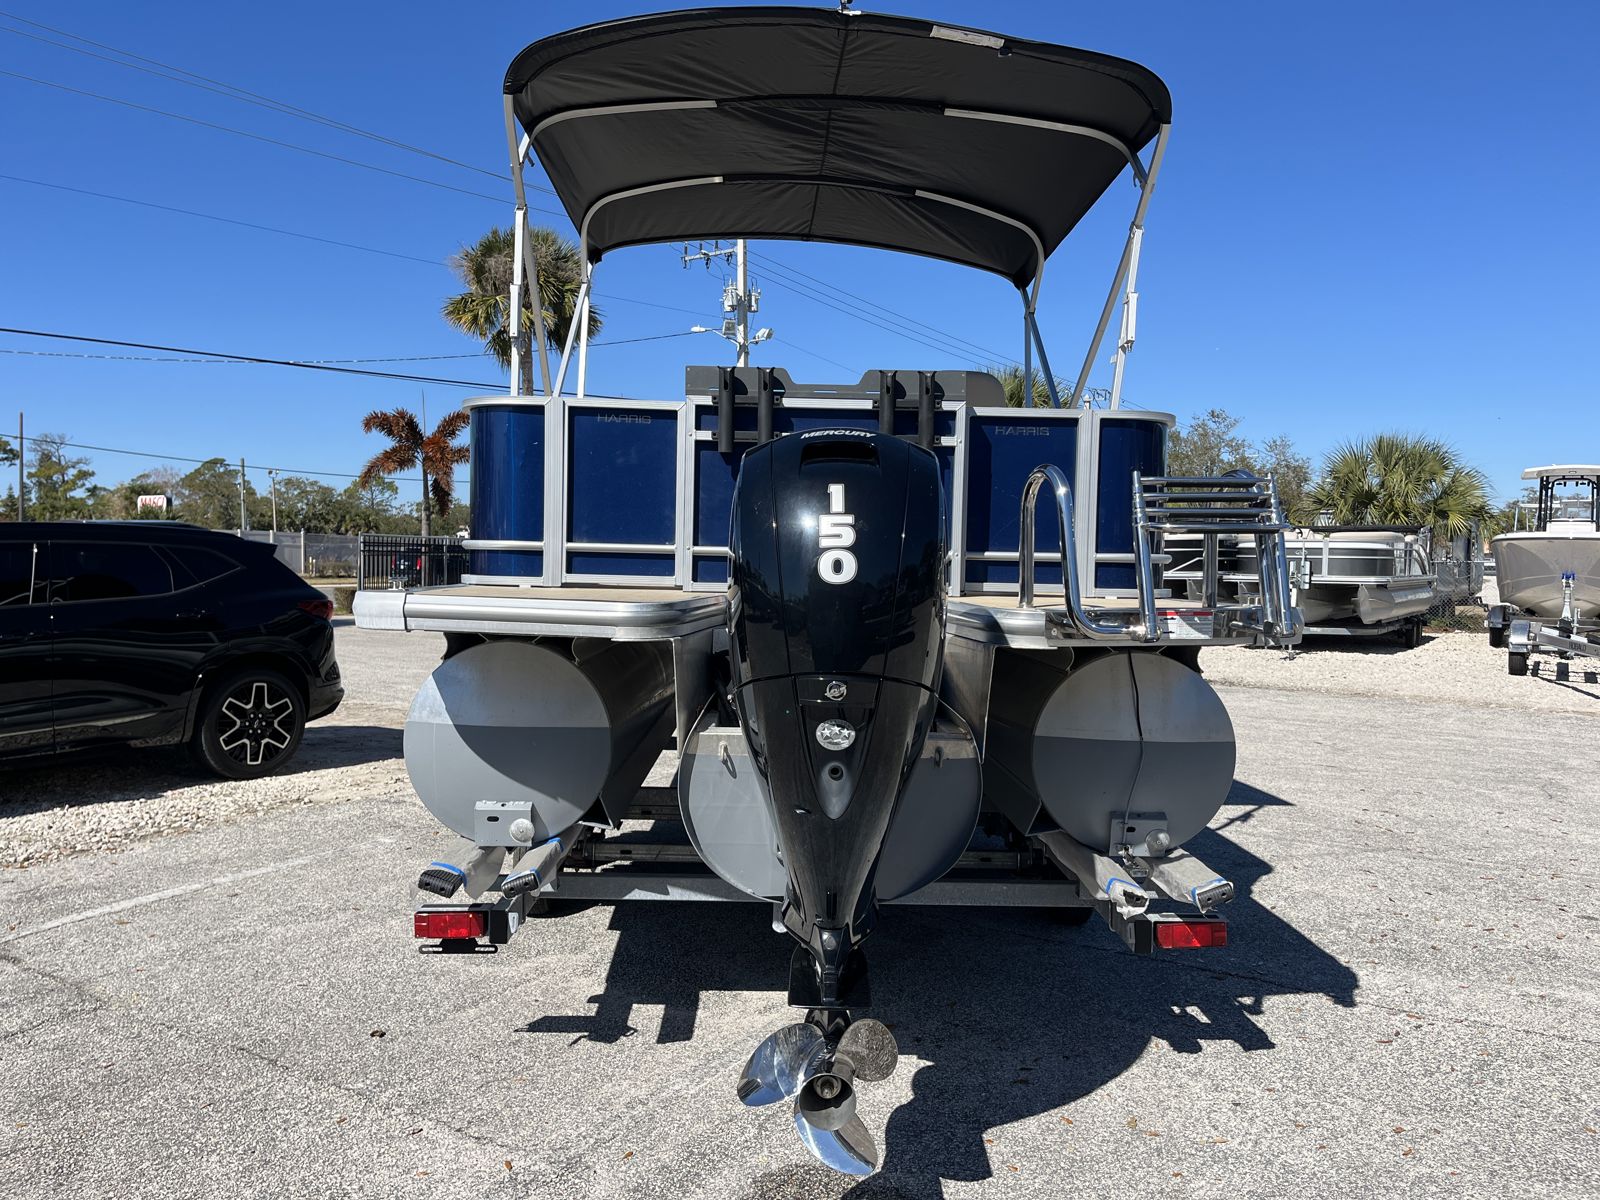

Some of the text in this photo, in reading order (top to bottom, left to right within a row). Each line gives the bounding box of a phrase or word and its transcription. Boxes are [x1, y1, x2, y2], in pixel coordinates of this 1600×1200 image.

[597, 413, 652, 424] HARRIS
[800, 429, 877, 439] MERCURY
[995, 425, 1050, 436] HARRIS
[817, 483, 858, 585] 150
